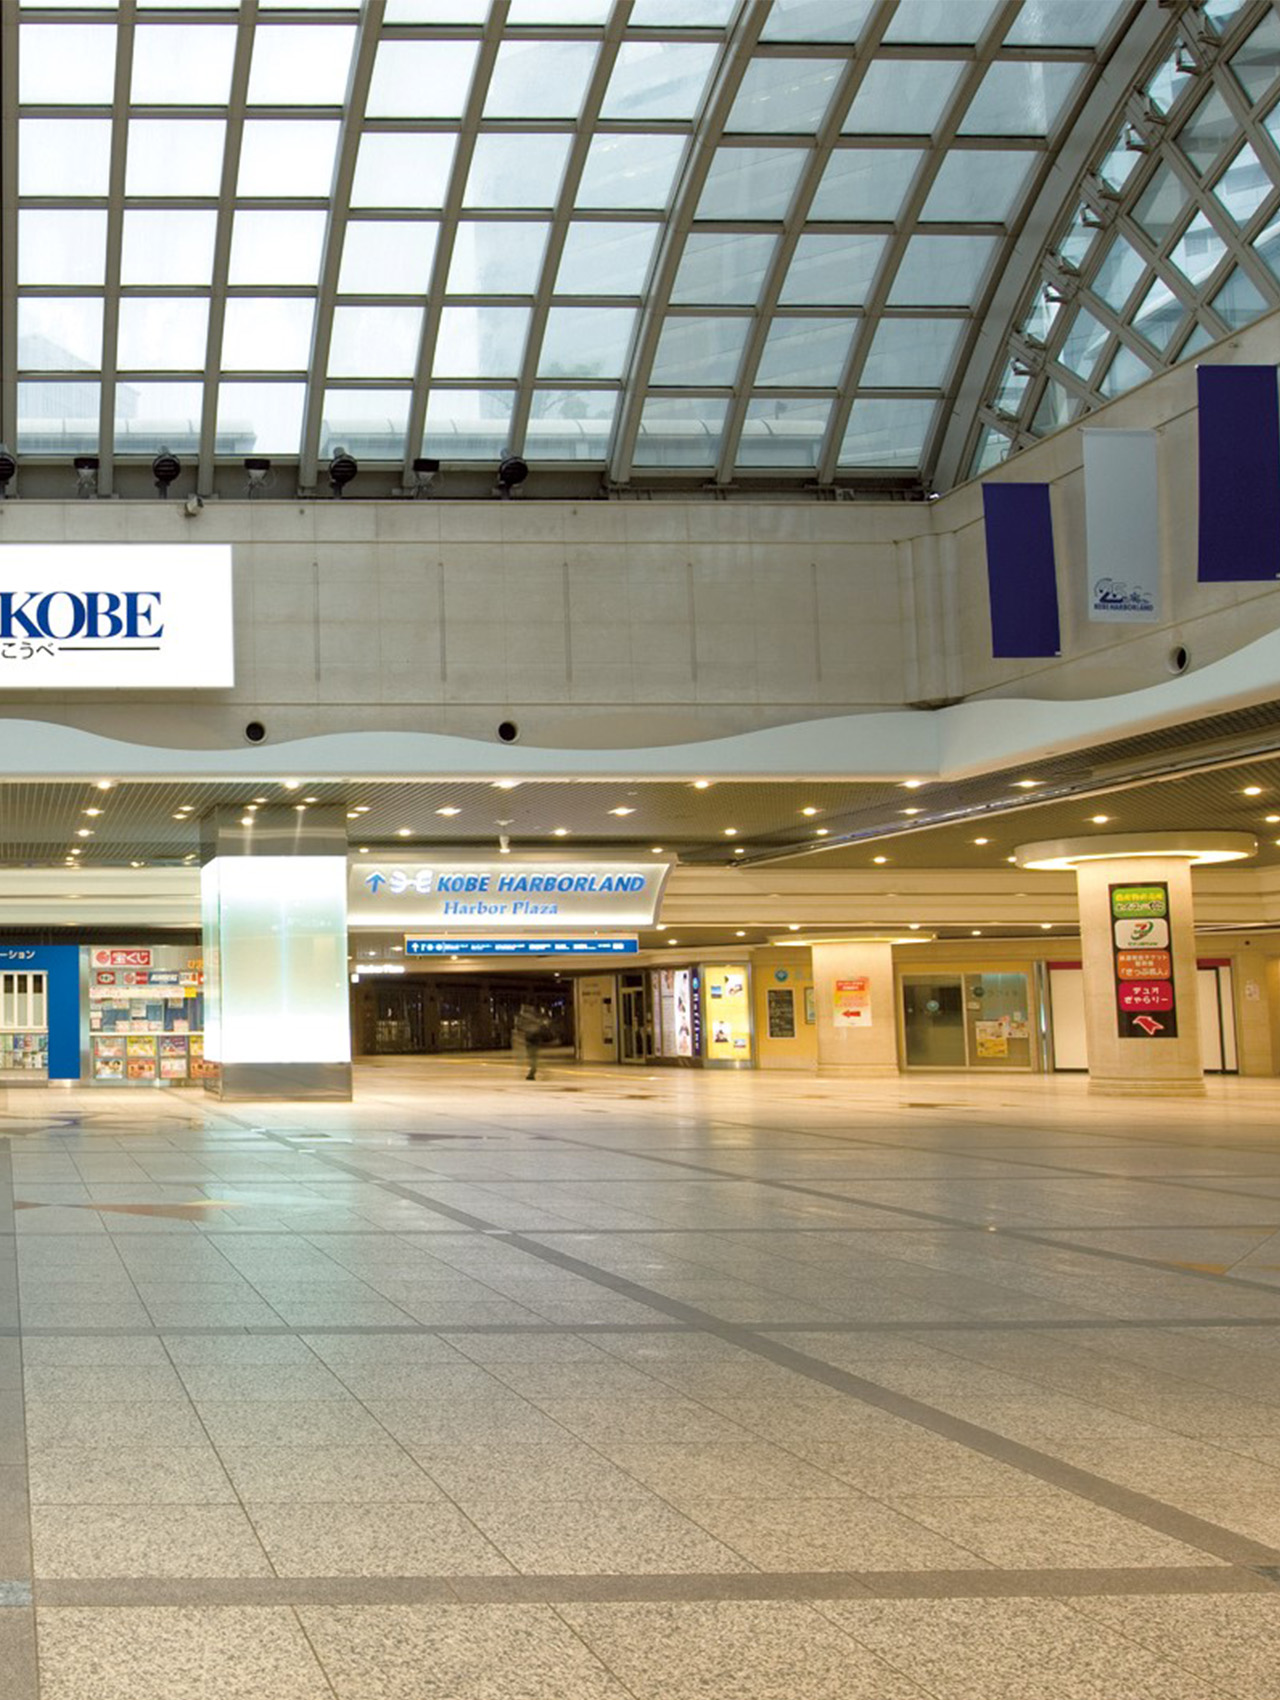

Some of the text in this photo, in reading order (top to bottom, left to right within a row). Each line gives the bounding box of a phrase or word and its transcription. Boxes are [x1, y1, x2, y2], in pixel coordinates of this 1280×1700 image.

[436, 873, 646, 893] KOBE HARBORLAND
[443, 901, 559, 915] Harbor Plaza
[1132, 987, 1159, 995] デュオ
[1124, 995, 1169, 1005] ぎゃらりー
